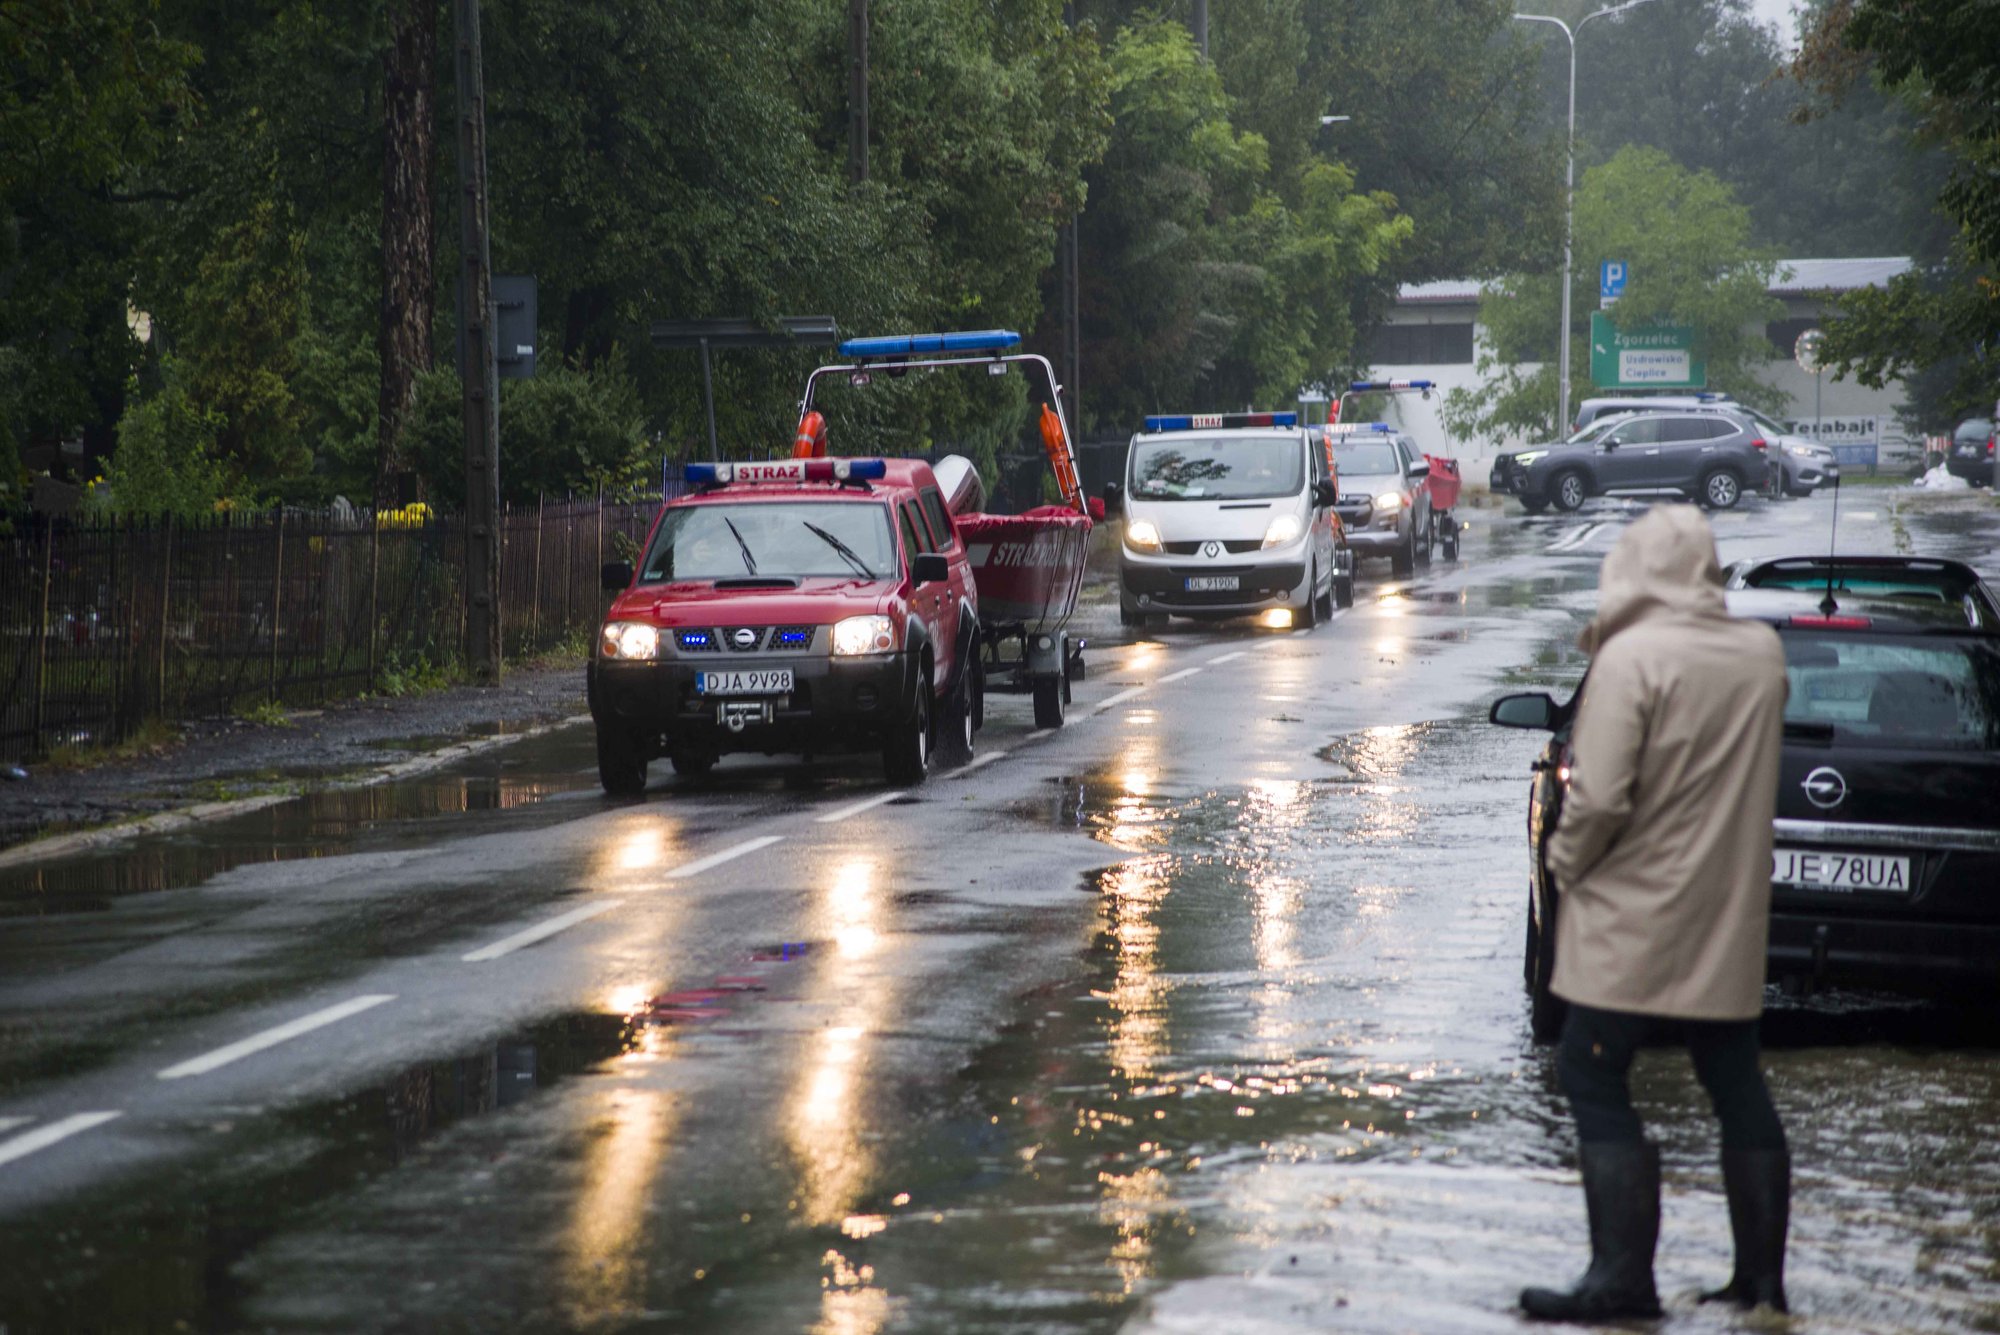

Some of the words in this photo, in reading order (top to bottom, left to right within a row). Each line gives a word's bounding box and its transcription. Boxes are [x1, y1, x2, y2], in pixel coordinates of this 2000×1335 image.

[1607, 263, 1622, 287] P
[1614, 332, 1678, 348] Zgorzelec
[1626, 354, 1682, 365] Uzdrowisko
[1626, 368, 1666, 379] Cieplice
[1784, 419, 1875, 436] Terabajt
[707, 673, 743, 690] DJA
[749, 671, 790, 689] 9V98
[1772, 853, 1821, 883] JE
[1831, 855, 1904, 888] 78UA
